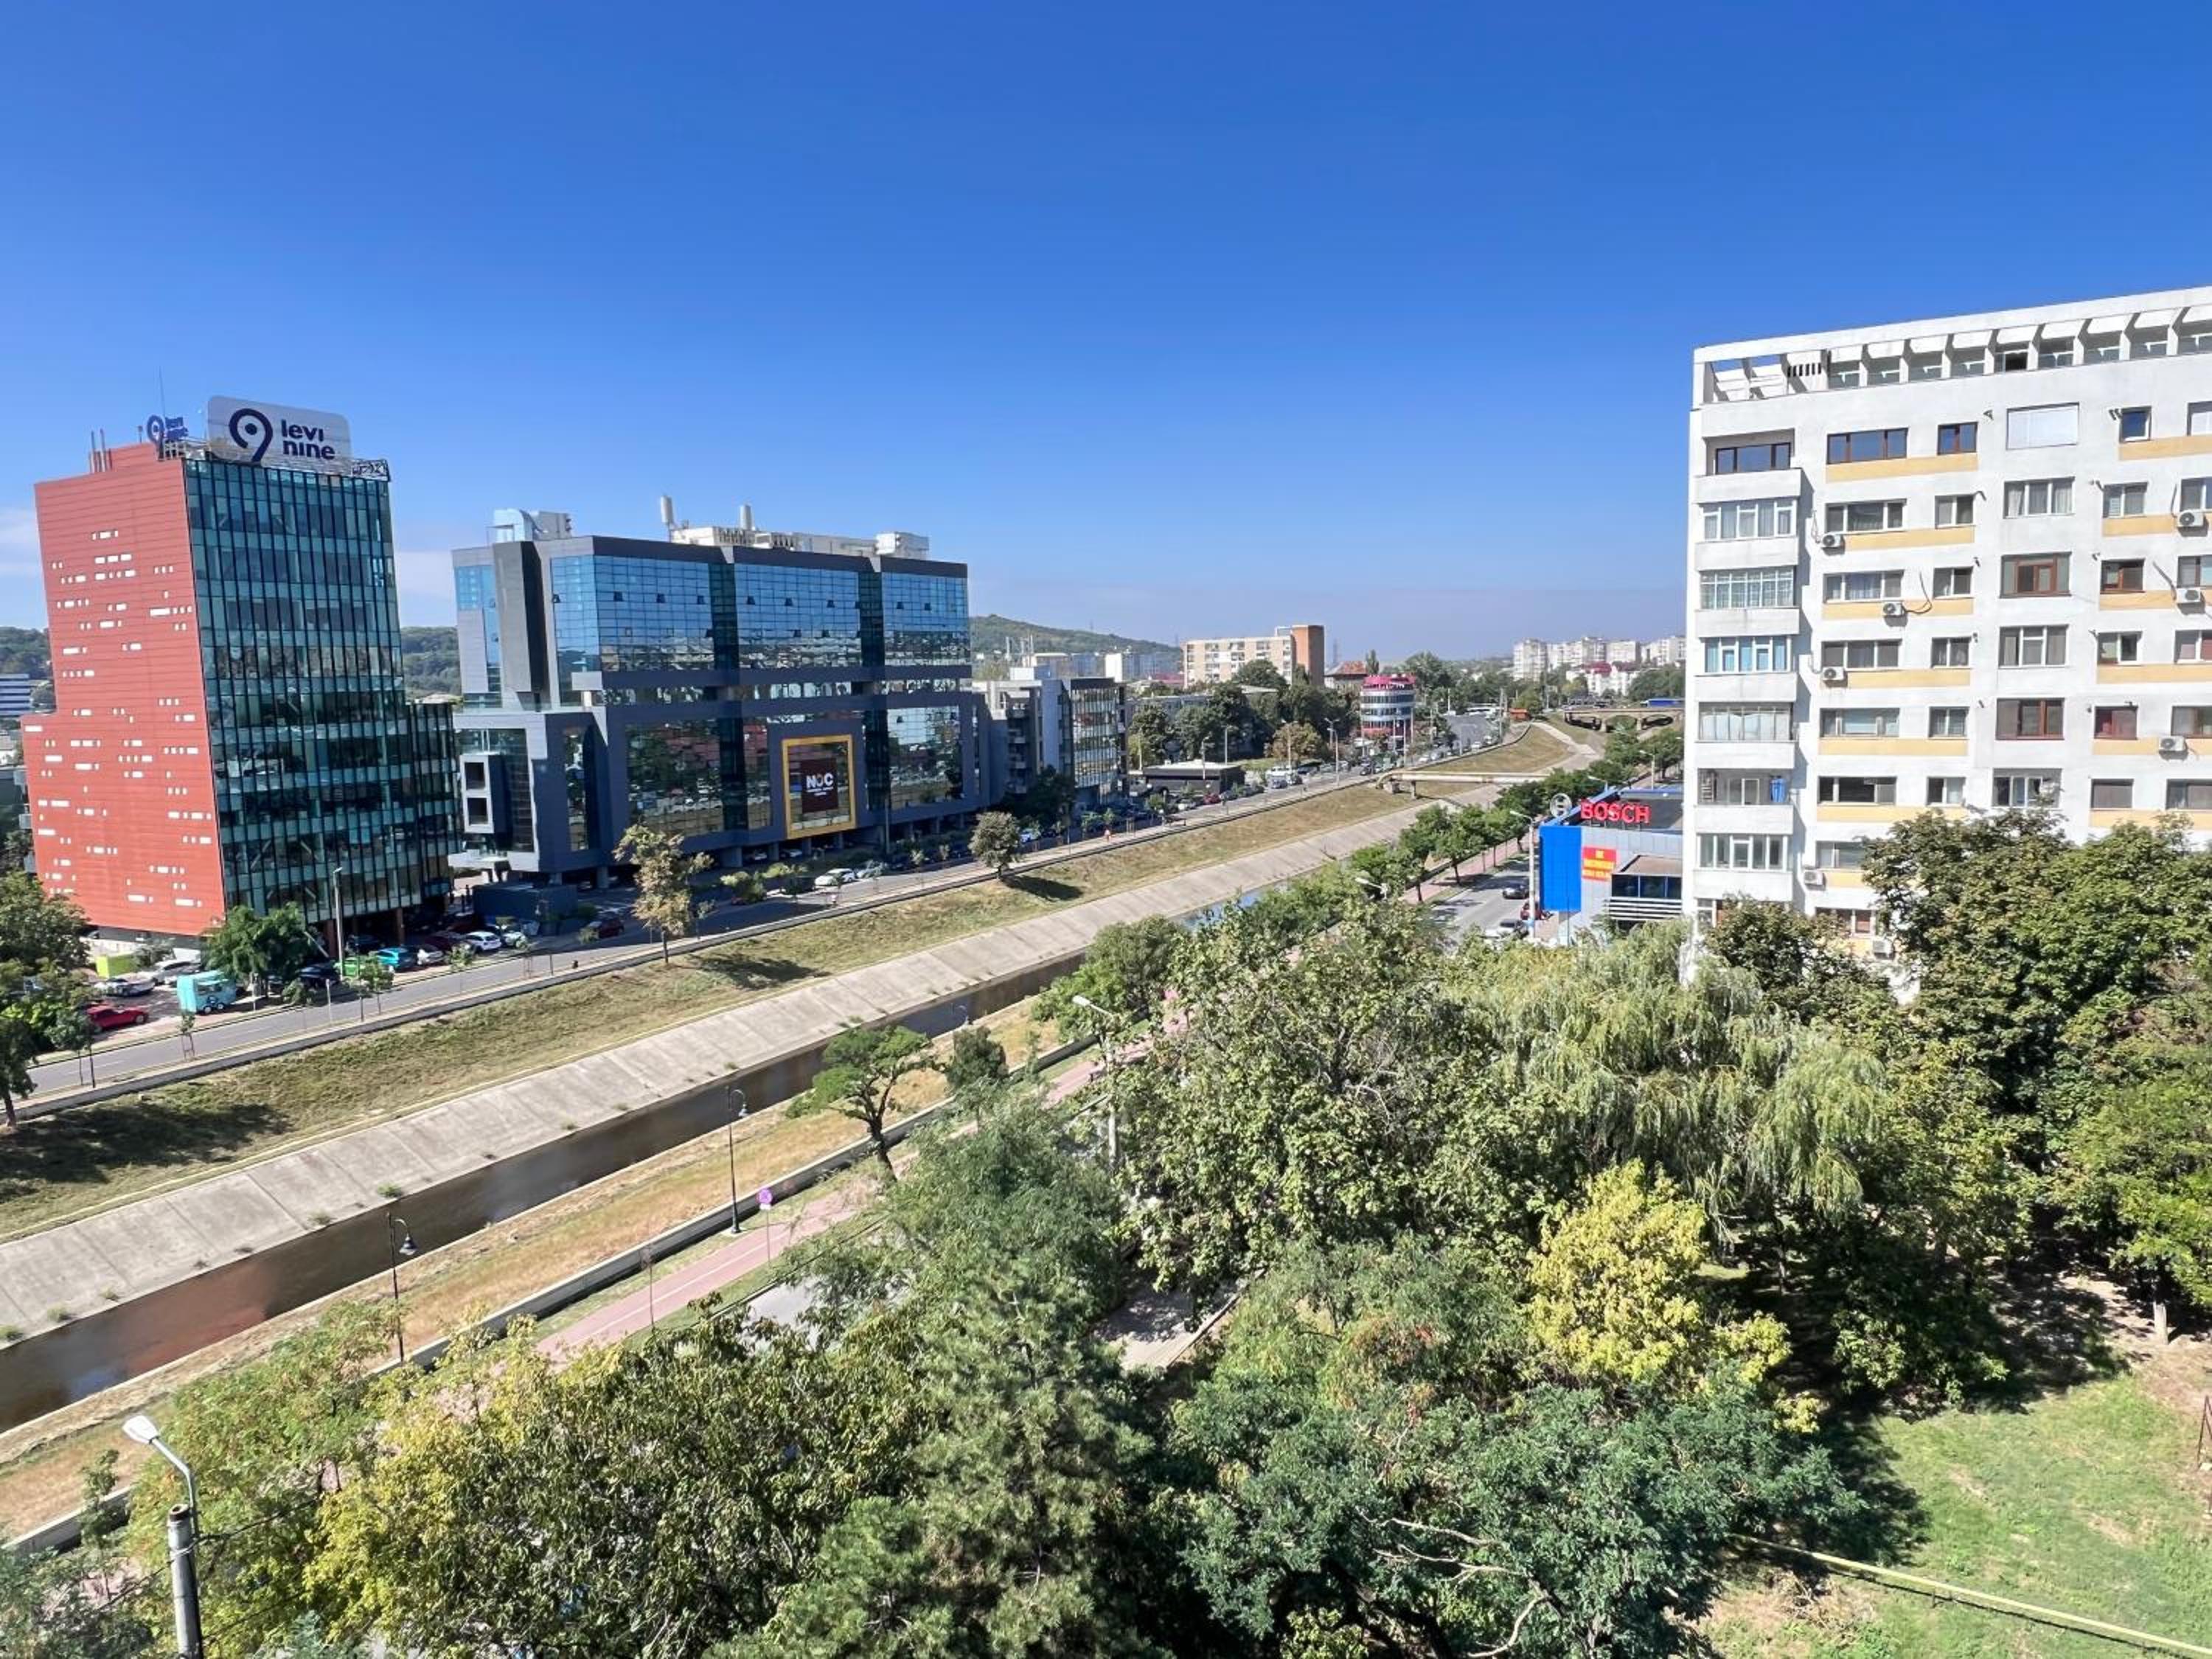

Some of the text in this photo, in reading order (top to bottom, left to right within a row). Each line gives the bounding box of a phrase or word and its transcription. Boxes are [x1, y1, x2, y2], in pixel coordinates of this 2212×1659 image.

[281, 419, 324, 442] levi
[282, 440, 335, 460] nine
[806, 772, 833, 788] NOC
[1580, 799, 1650, 824] BOSCH
